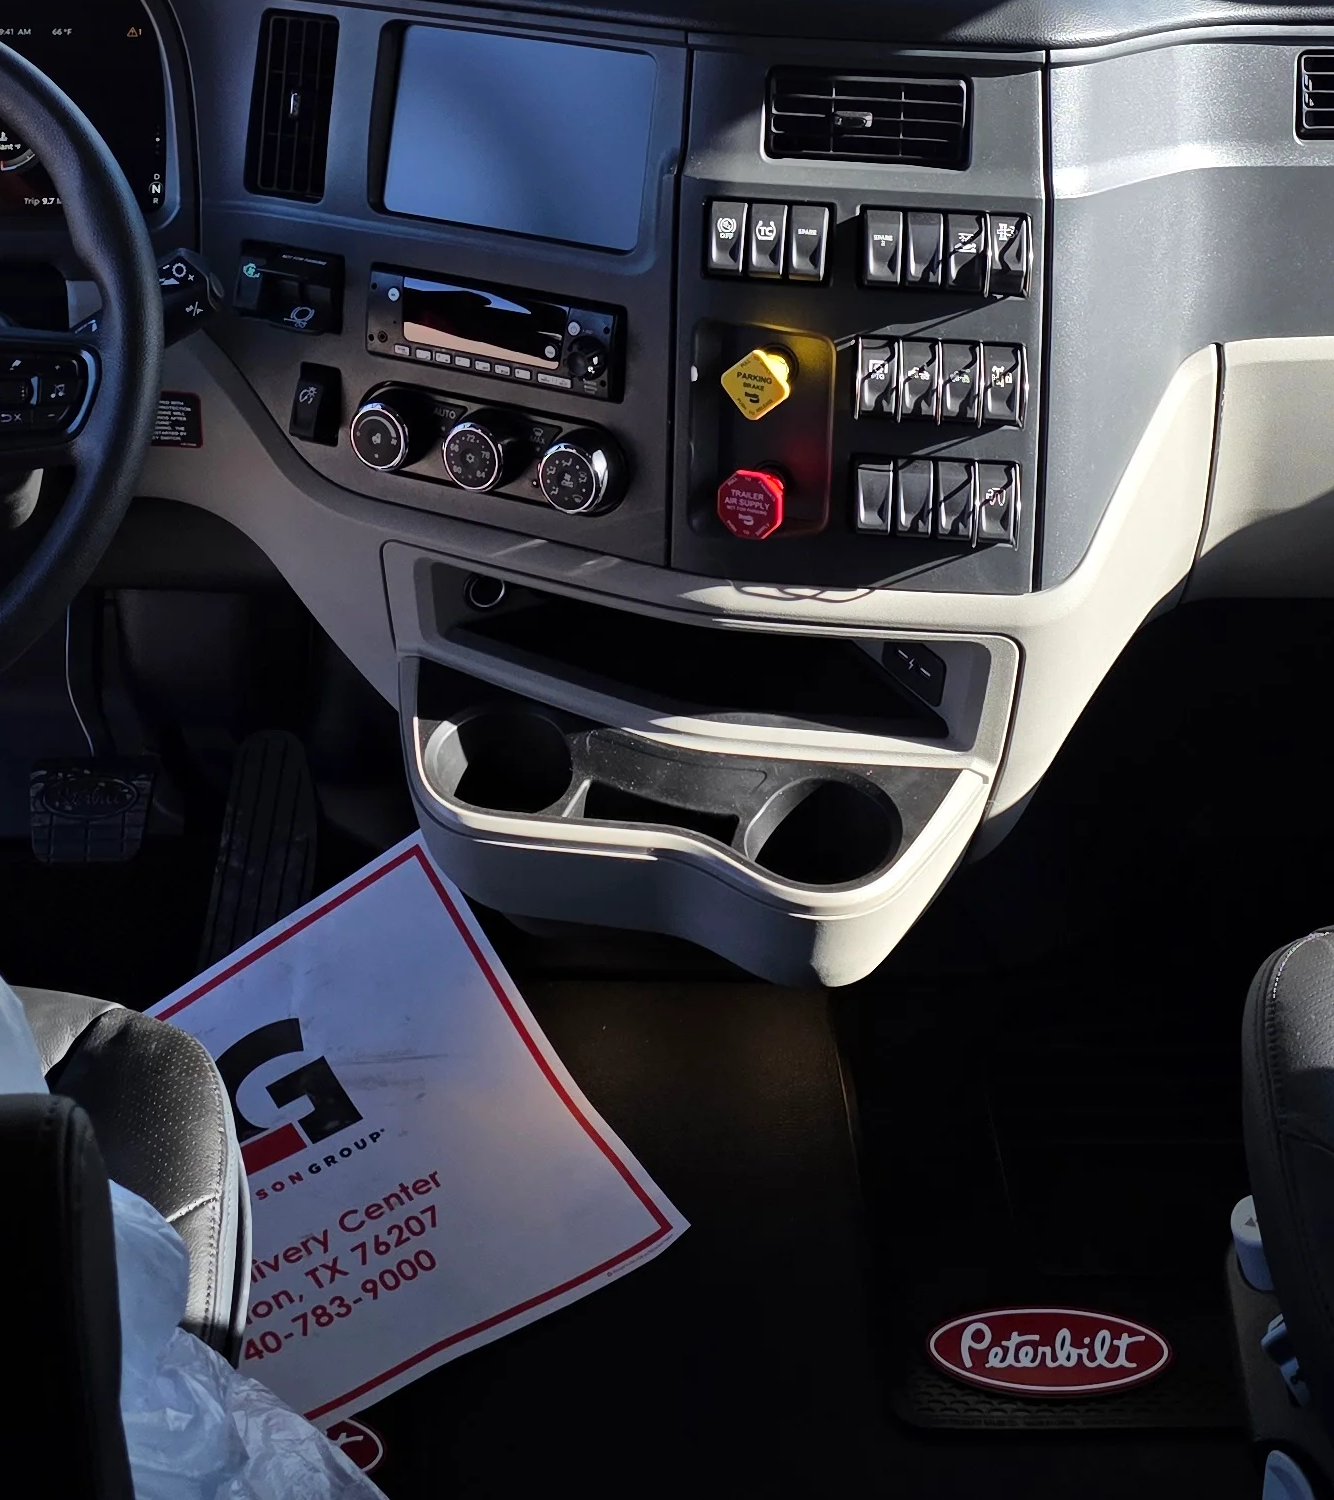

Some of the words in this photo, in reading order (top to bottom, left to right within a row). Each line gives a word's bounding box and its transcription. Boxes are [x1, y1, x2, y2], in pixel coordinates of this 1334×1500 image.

[0, 28, 14, 36] 9:41
[18, 28, 32, 36] AM
[151, 184, 161, 194] N
[24, 197, 41, 206] Trip
[759, 226, 774, 236] TC
[737, 371, 772, 385] PARKING
[743, 382, 765, 391] BRAKE
[433, 407, 456, 419] AUTO
[466, 434, 476, 443] 72
[730, 489, 764, 501] TRAILER
[724, 497, 737, 505] AIR
[738, 499, 770, 511] SUPPLY
[255, 1171, 304, 1200] SON
[308, 1130, 382, 1175] GROUP
[251, 1228, 329, 1283] ivery
[338, 1170, 442, 1233] Center
[304, 1255, 350, 1289] TX
[350, 1204, 438, 1266] 76207
[244, 1249, 437, 1361] 40-783-9000
[960, 1321, 1146, 1369] Peterbilt
